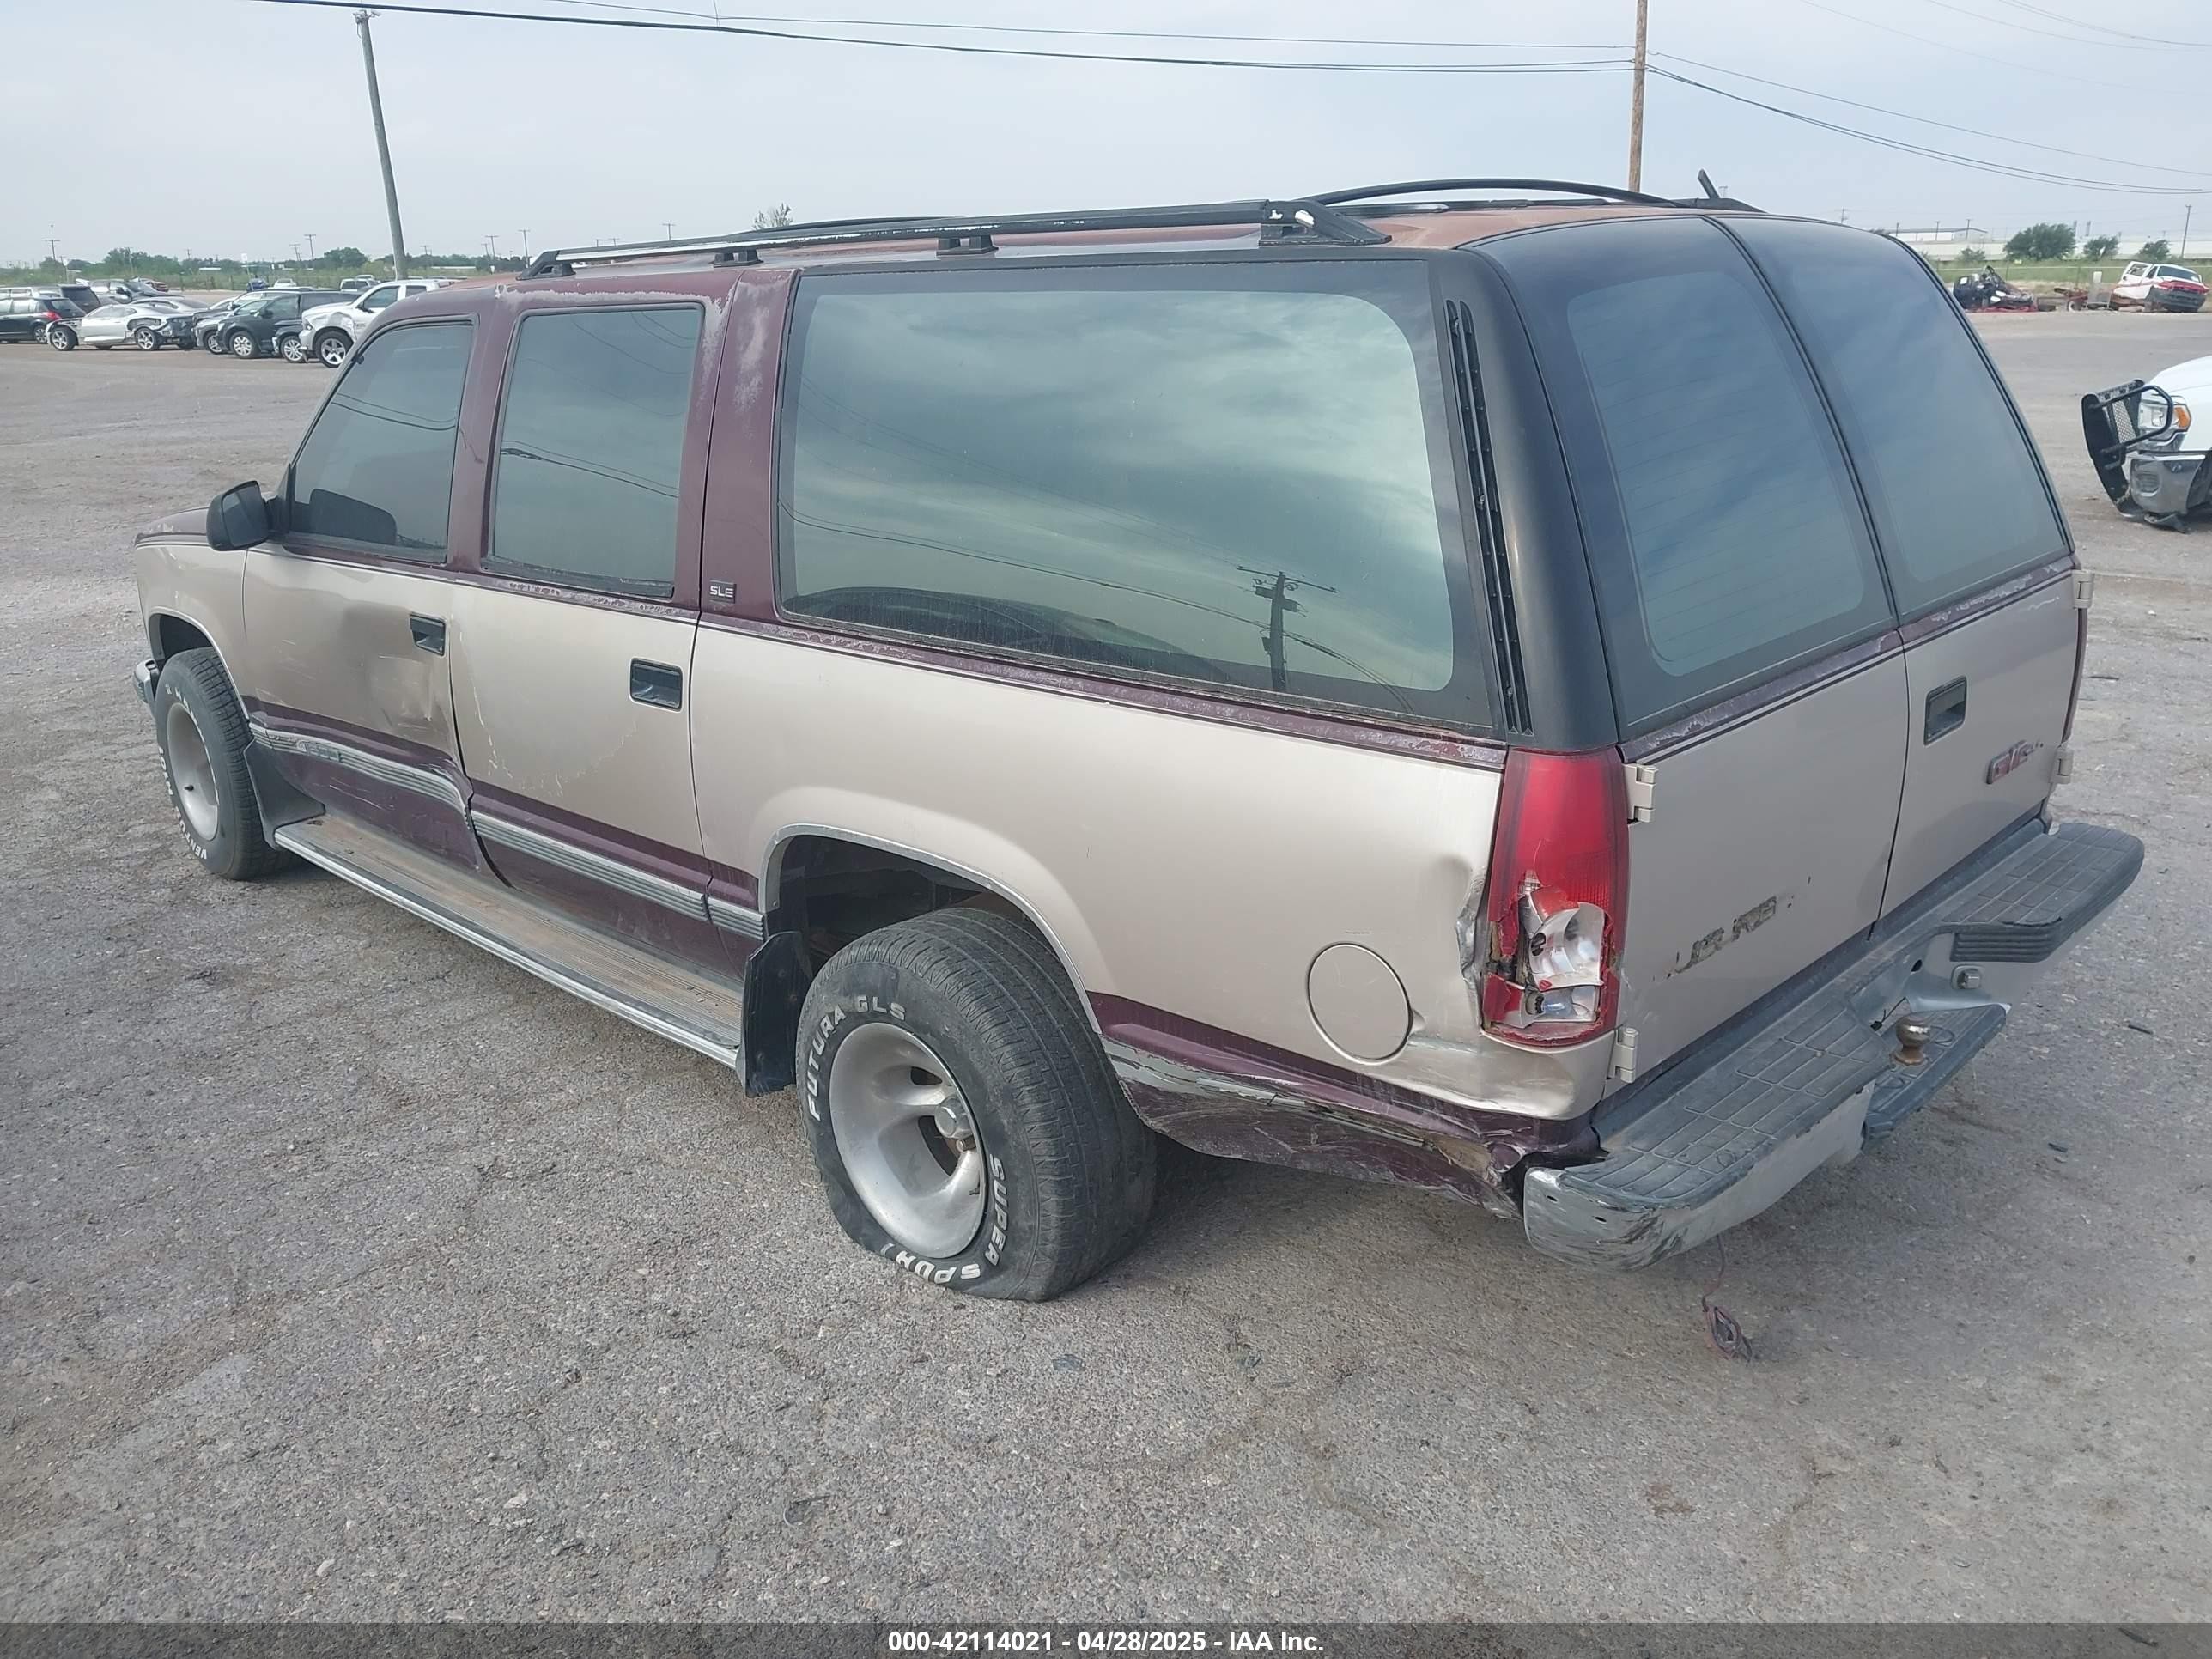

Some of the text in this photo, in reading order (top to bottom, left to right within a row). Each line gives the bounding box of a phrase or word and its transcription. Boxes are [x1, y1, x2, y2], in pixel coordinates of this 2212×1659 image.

[709, 586, 734, 599] SLE
[806, 994, 906, 1121] FUTURA GLS
[984, 1153, 1009, 1266] SUPER
